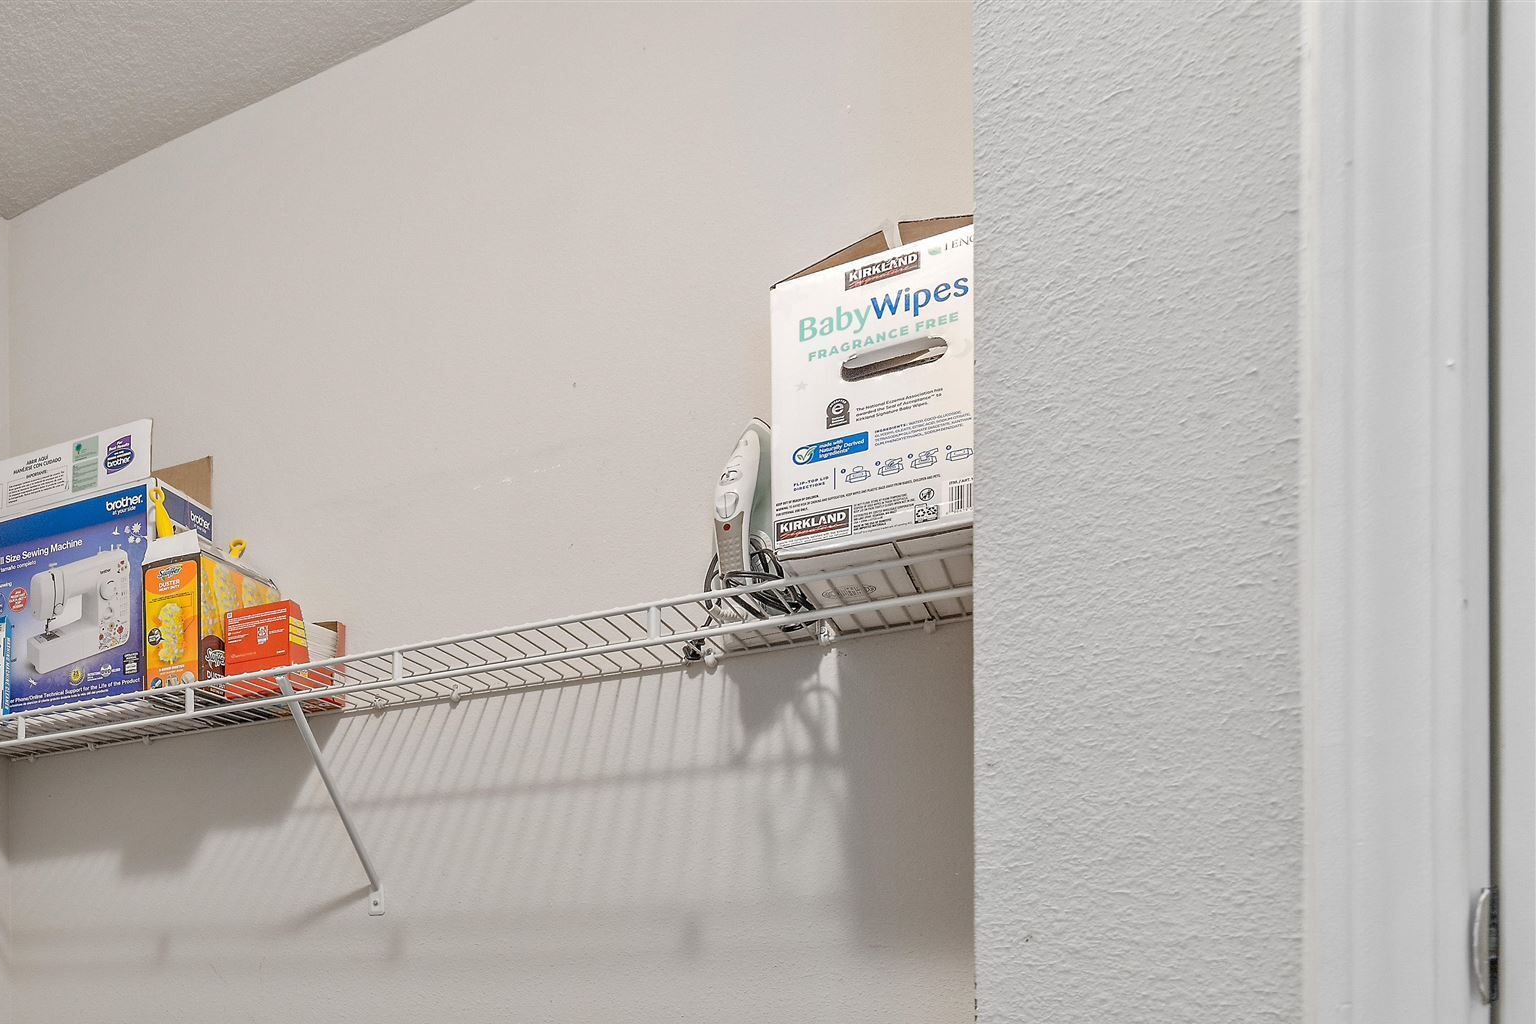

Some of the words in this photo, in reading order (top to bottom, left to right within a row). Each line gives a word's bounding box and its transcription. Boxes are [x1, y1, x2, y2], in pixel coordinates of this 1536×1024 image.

[848, 253, 918, 282] KIRKLAND
[808, 326, 909, 362] FRAGRANCE
[915, 312, 959, 332] FREE
[844, 438, 865, 447] Derived
[780, 512, 846, 533] KIRKLAND
[5, 554, 21, 563] Size
[22, 546, 48, 560] Sewing
[50, 539, 83, 553] Machine
[44, 689, 64, 698] Technical
[65, 686, 82, 694] Support
[122, 677, 140, 685] Product
